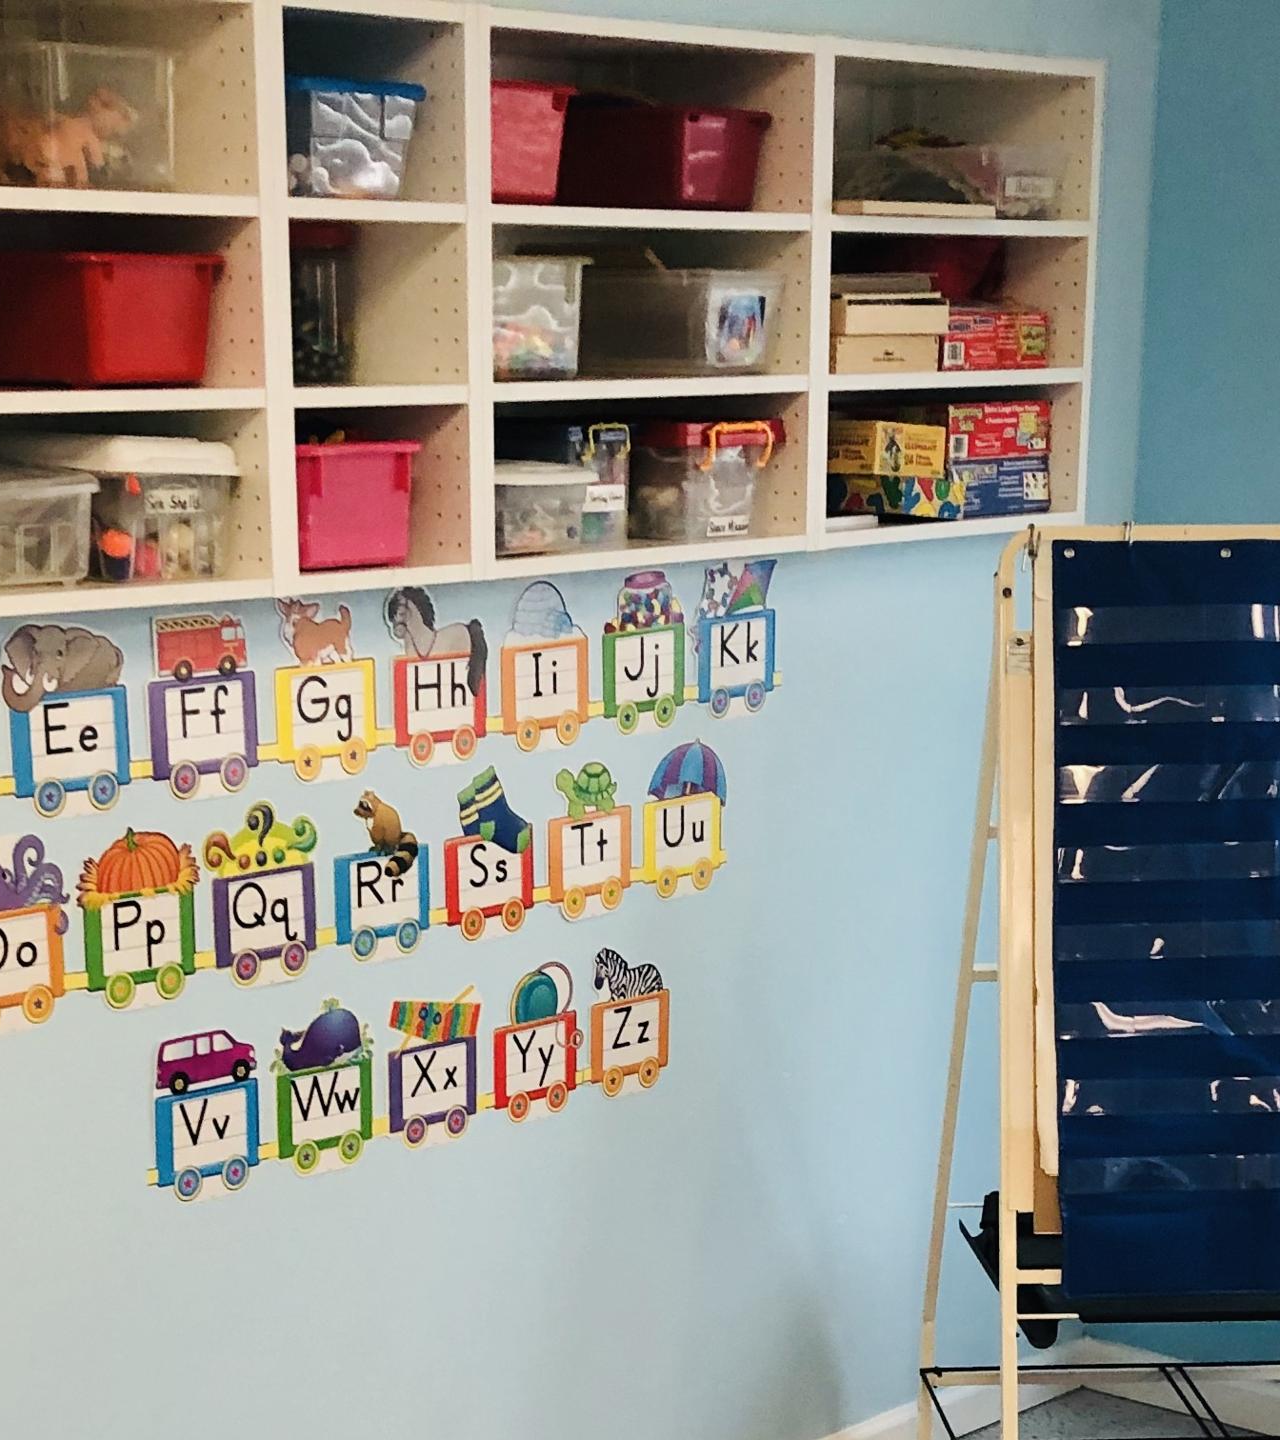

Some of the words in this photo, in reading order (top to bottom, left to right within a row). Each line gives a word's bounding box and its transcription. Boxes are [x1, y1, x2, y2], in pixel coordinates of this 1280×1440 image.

[43, 703, 98, 755] Ee
[180, 685, 229, 738] Ff
[297, 676, 353, 741] Gg
[414, 665, 467, 711] Hh
[532, 652, 558, 697] Ii
[625, 636, 661, 697] Jj
[720, 623, 758, 667] Kk
[113, 900, 165, 967] Pp
[232, 882, 298, 942] Qq
[470, 844, 508, 887] Ss
[571, 823, 608, 866] Tt
[662, 805, 704, 847] Uu
[179, 1099, 229, 1145] Vv
[291, 1073, 360, 1121] Ww
[411, 1051, 458, 1098] Xx
[512, 1031, 553, 1087] Yy
[613, 1007, 651, 1050] Zz
